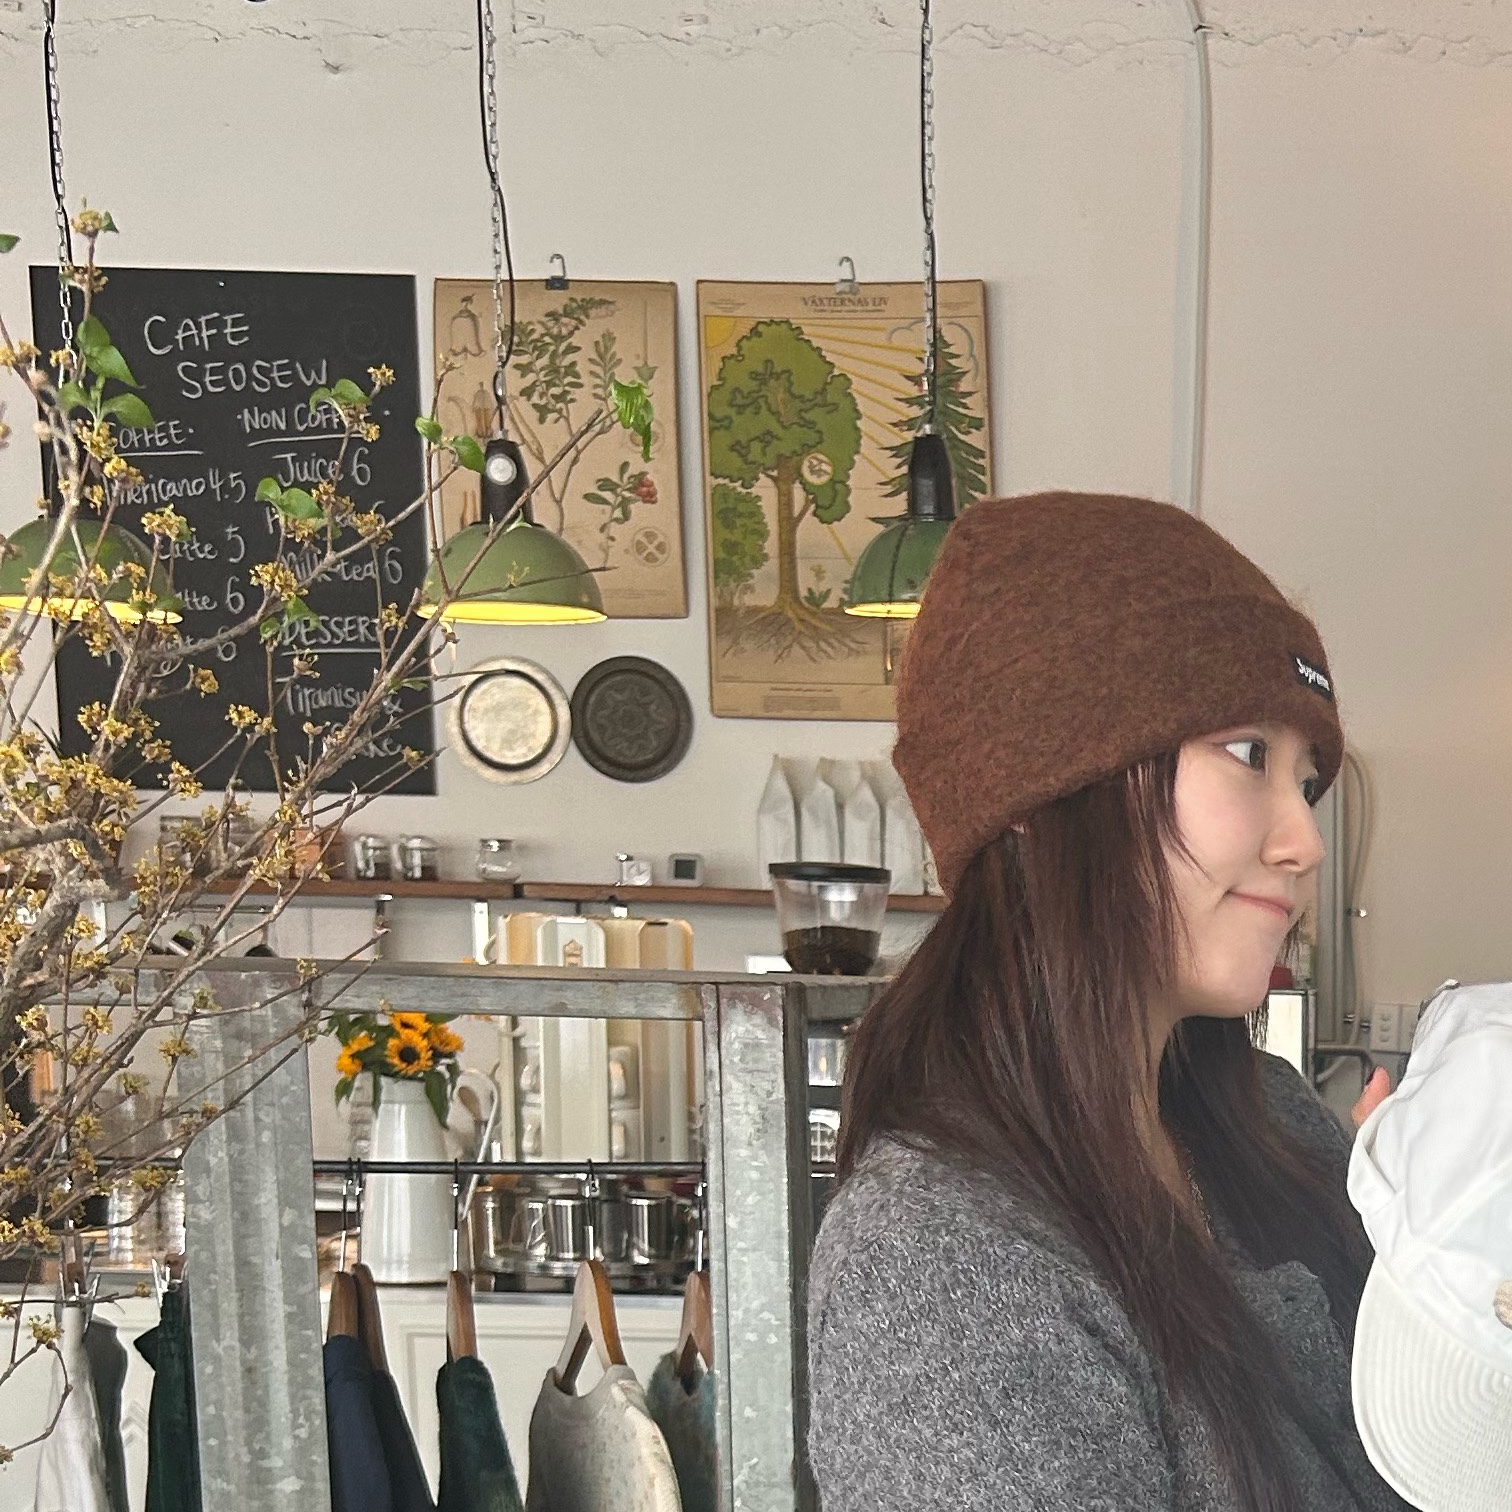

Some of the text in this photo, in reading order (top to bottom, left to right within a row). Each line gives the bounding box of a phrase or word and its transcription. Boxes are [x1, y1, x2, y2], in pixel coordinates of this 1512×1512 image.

[143, 312, 250, 356] CAFE
[176, 358, 328, 400] SEOSEW
[106, 420, 187, 449] OFFEE
[243, 402, 372, 434] NON COFF
[208, 467, 247, 503] 4.5
[272, 446, 372, 488] Juice 6
[224, 524, 246, 564] 5
[384, 546, 403, 585] 6
[225, 575, 246, 615] 6
